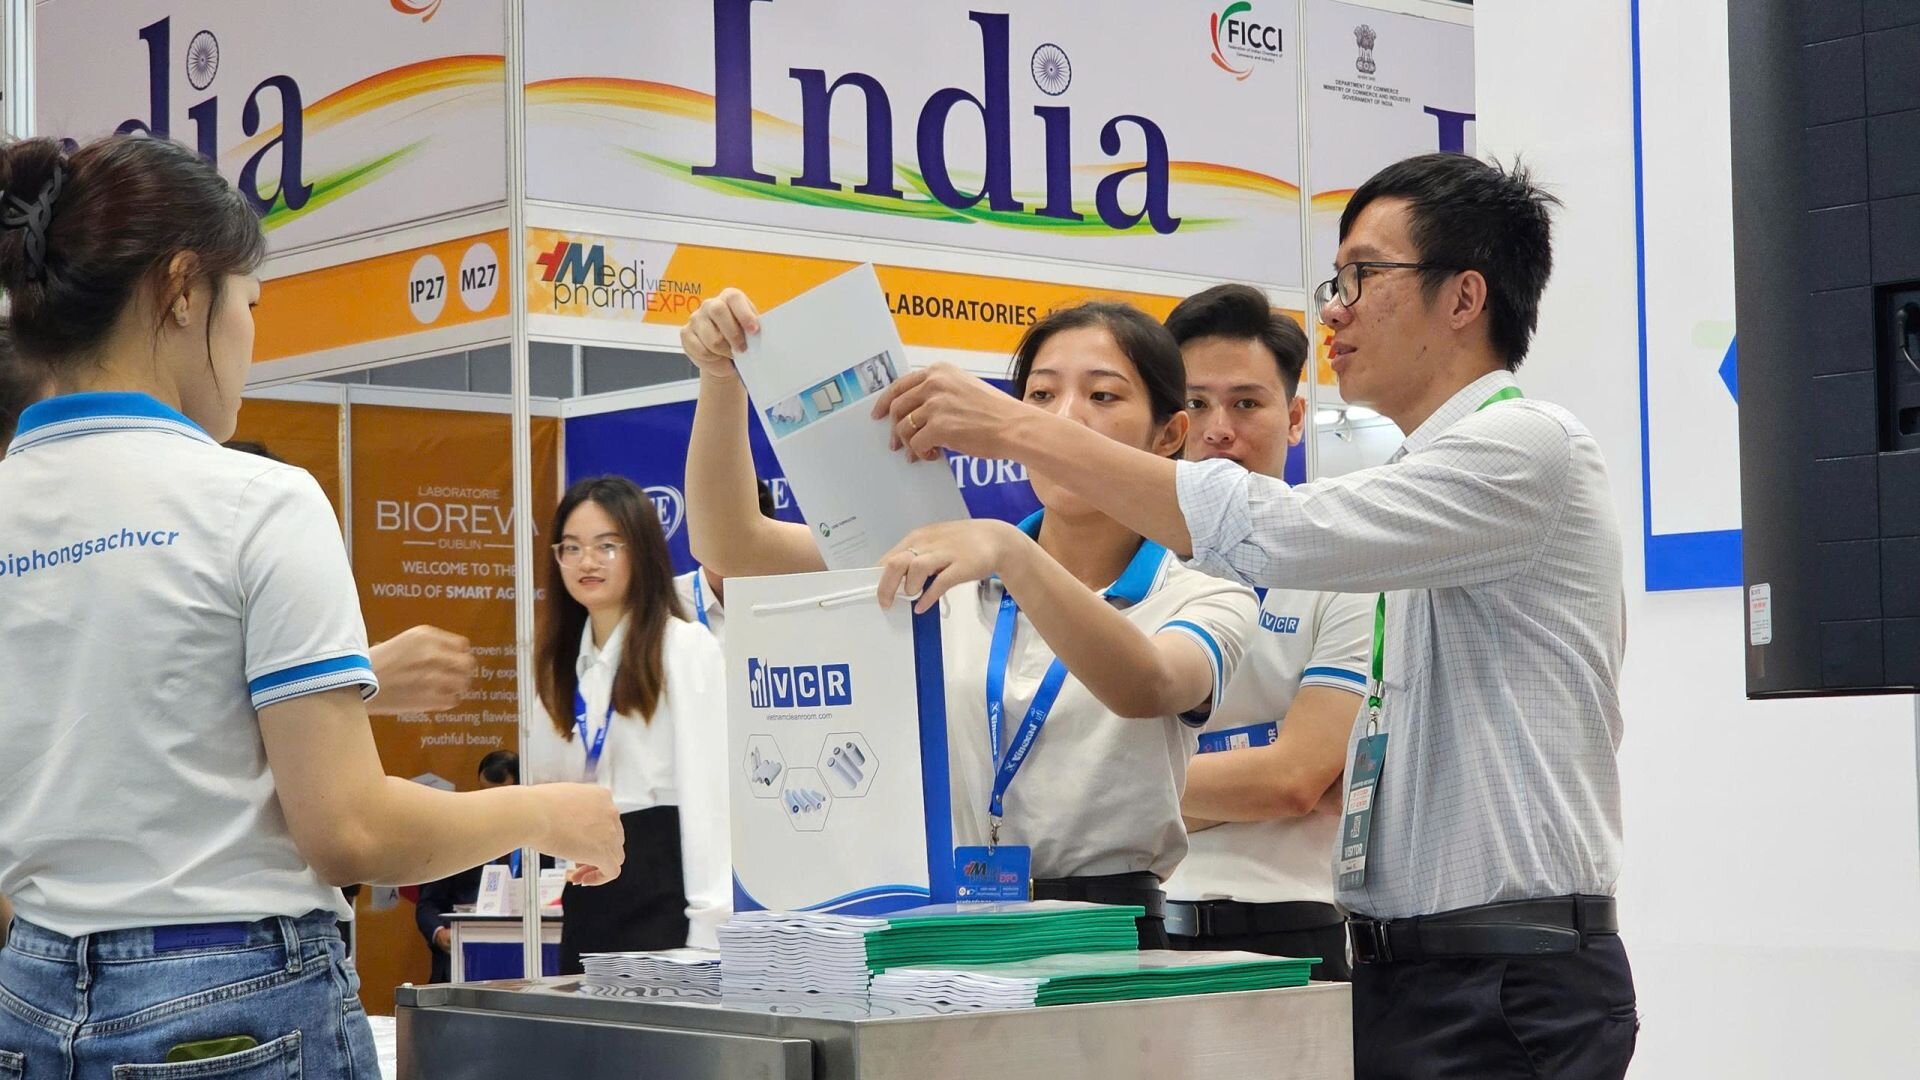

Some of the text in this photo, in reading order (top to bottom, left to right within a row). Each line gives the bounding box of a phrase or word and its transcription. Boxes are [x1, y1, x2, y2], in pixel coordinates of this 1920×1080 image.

[1228, 19, 1282, 52] FICCI
[1323, 84, 1344, 92] MINISTRY
[1353, 89, 1378, 98] COMMERCE
[1335, 79, 1365, 89] DEPARTMENT
[1373, 86, 1399, 95] COMMERCE
[1342, 94, 1373, 104] GOVERNMENT
[60, 16, 314, 213] dia
[692, 0, 1181, 234] India
[555, 242, 645, 290] Medi
[462, 264, 496, 291] M27
[411, 276, 444, 304] IP27
[646, 278, 701, 295] VIETNAM
[554, 282, 645, 311] pharm
[646, 292, 701, 314] EXPO
[885, 292, 1037, 326] LABORATORIES
[418, 486, 499, 499] LABORATORIE
[376, 500, 540, 536] BIOREV
[438, 539, 481, 550] DUBLIN
[402, 561, 468, 576] WELCOME
[470, 562, 490, 576] TO
[372, 584, 421, 597] WORLD
[425, 585, 442, 598] OF
[446, 586, 493, 599] SMART
[1263, 613, 1299, 631] VCR
[481, 667, 494, 680] by
[771, 669, 848, 701] VCR
[490, 690, 519, 703] uniqu
[435, 711, 480, 726] ensuring
[483, 710, 520, 723] flawles
[421, 732, 464, 748] youthful
